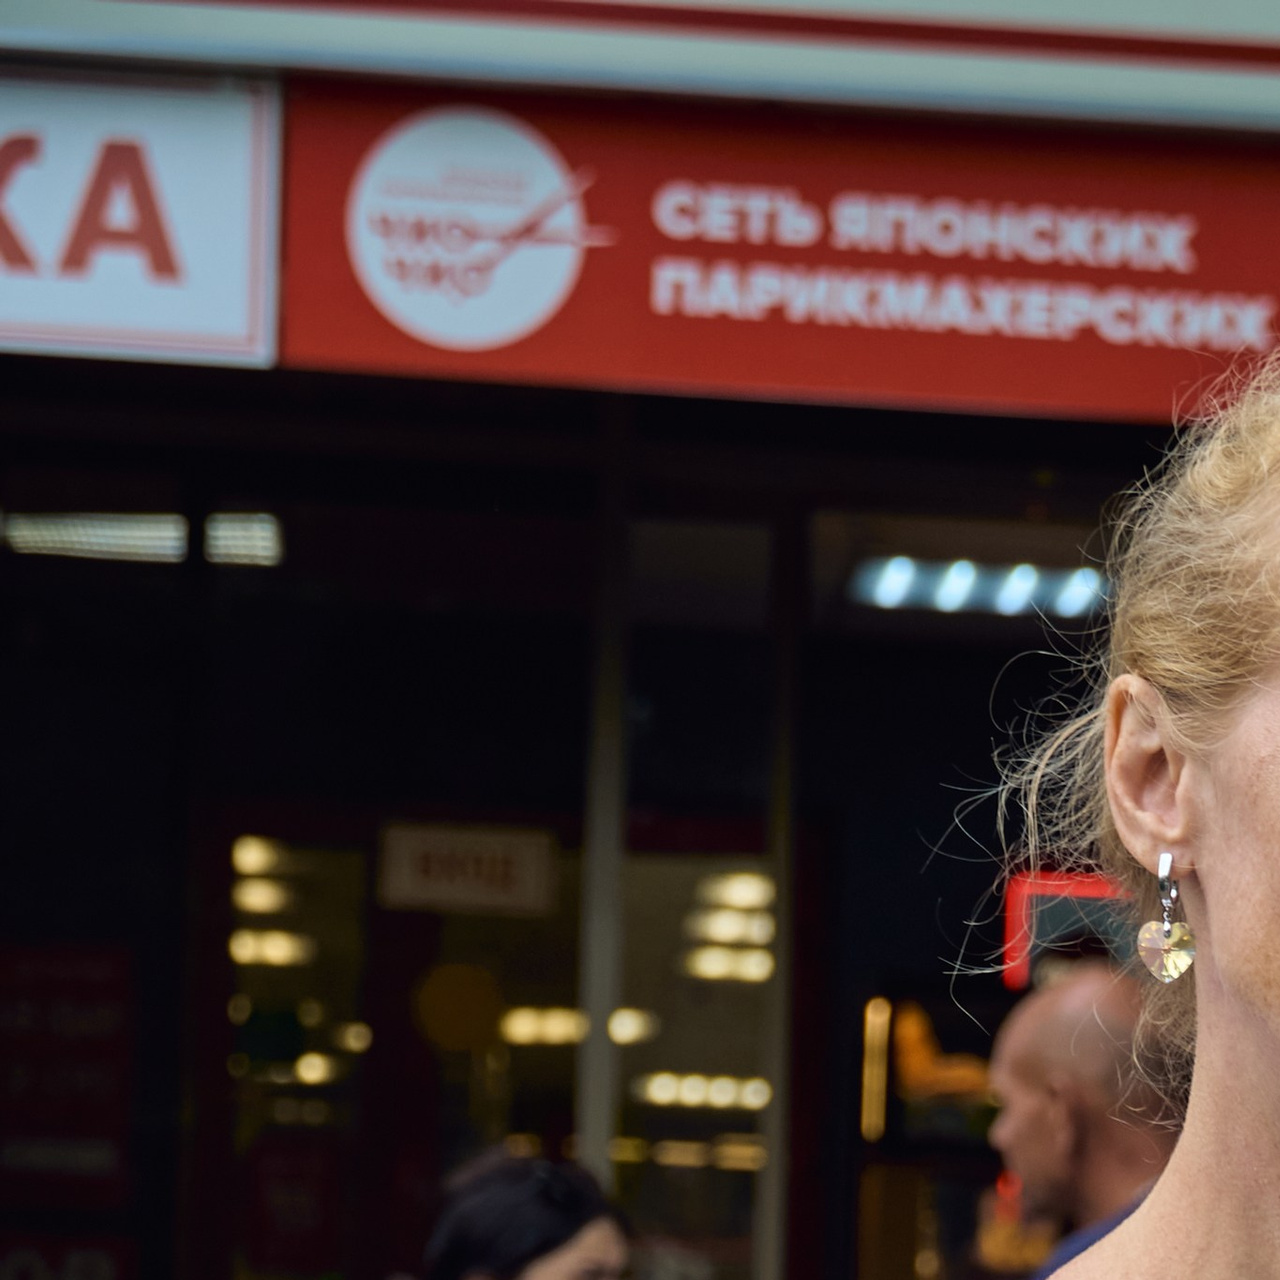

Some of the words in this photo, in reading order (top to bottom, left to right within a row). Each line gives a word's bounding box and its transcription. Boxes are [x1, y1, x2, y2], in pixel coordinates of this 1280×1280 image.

[652, 180, 822, 247] СЕТЬ
[830, 192, 1195, 273] ЯПОНСКИХ
[651, 257, 1276, 352] ПАРИКМАХЕРСКИХ
